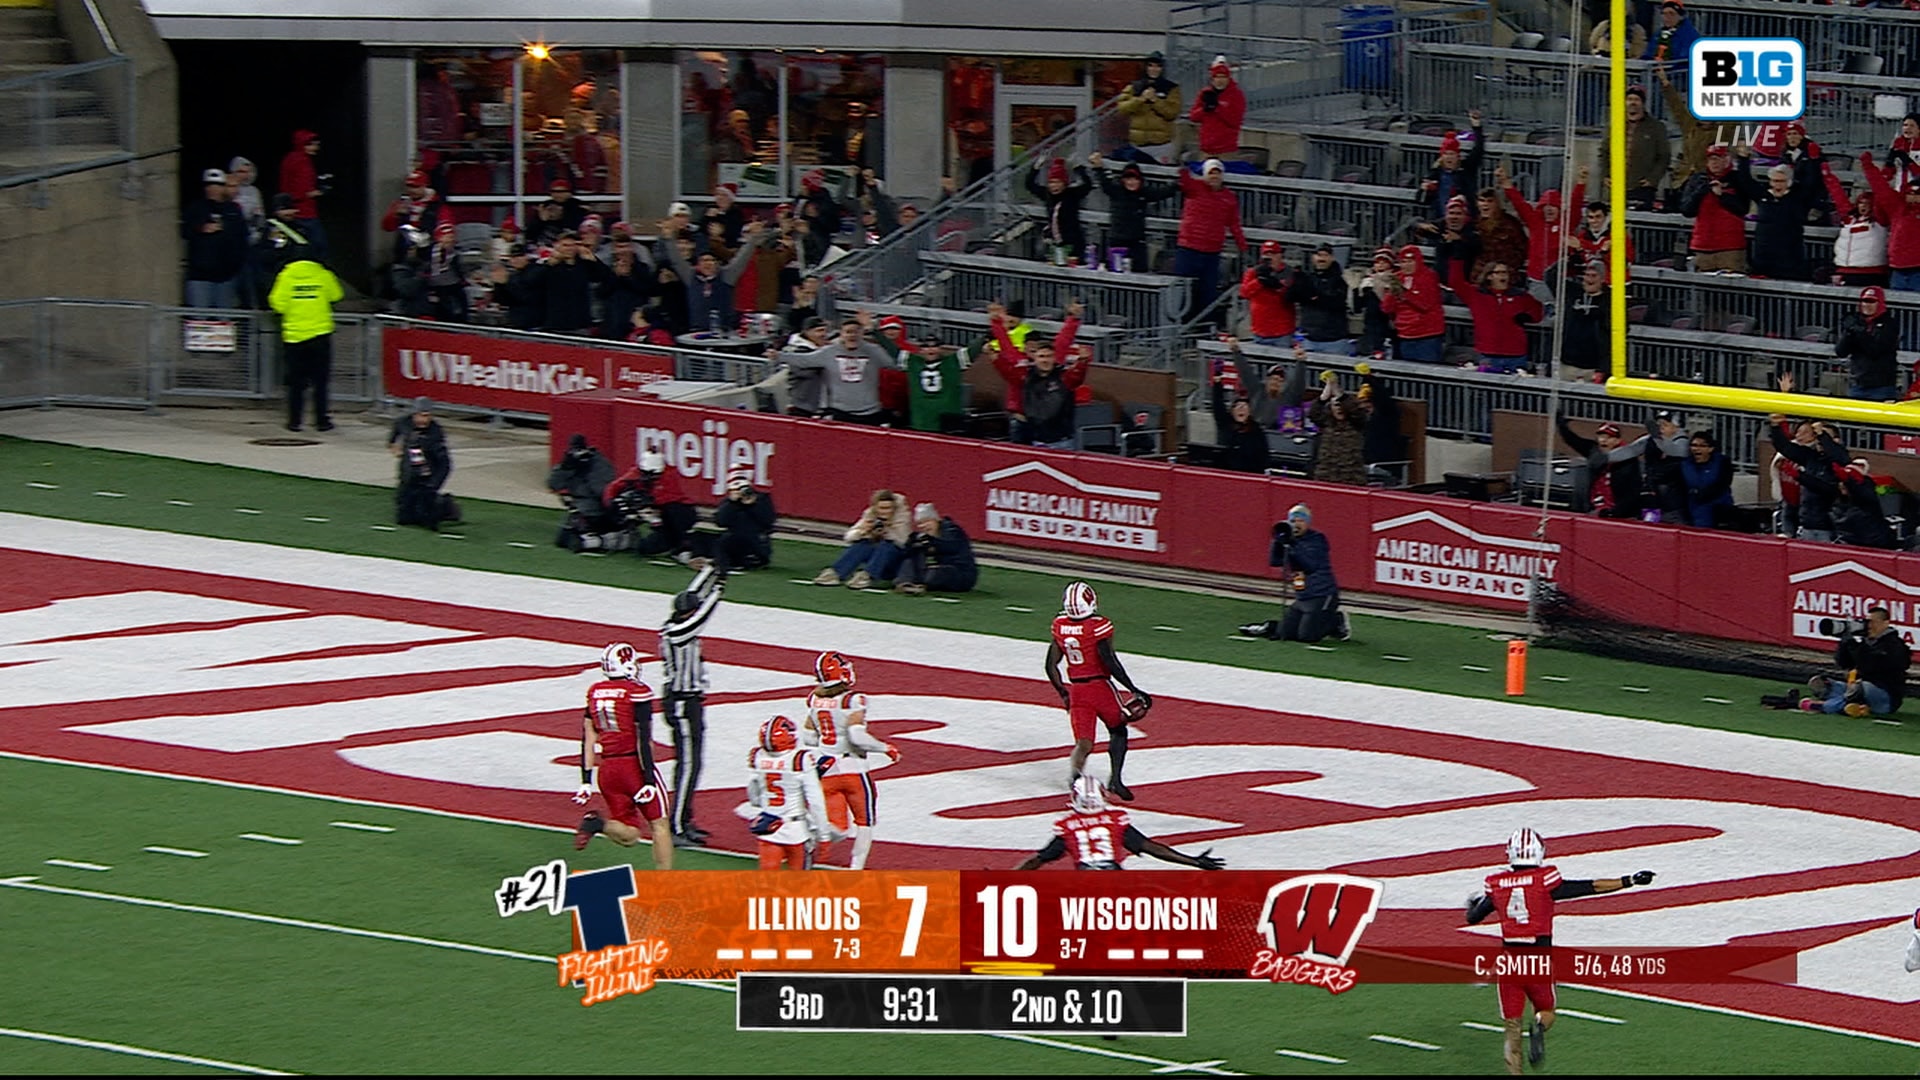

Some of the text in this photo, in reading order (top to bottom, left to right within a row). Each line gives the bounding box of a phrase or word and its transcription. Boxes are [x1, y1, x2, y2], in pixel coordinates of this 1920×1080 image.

[636, 419, 775, 495] meijer
[986, 488, 1158, 526] AMERICAN FAMILY
[1000, 515, 1144, 545] INSURANCE
[1376, 538, 1558, 579] AMERICAN FAMILY
[1390, 566, 1526, 596] INSURANC
[1064, 637, 1085, 665] 6
[596, 699, 621, 731] 11
[766, 773, 786, 807] 5
[1075, 827, 1114, 862] 13
[1507, 887, 1529, 924] 4
